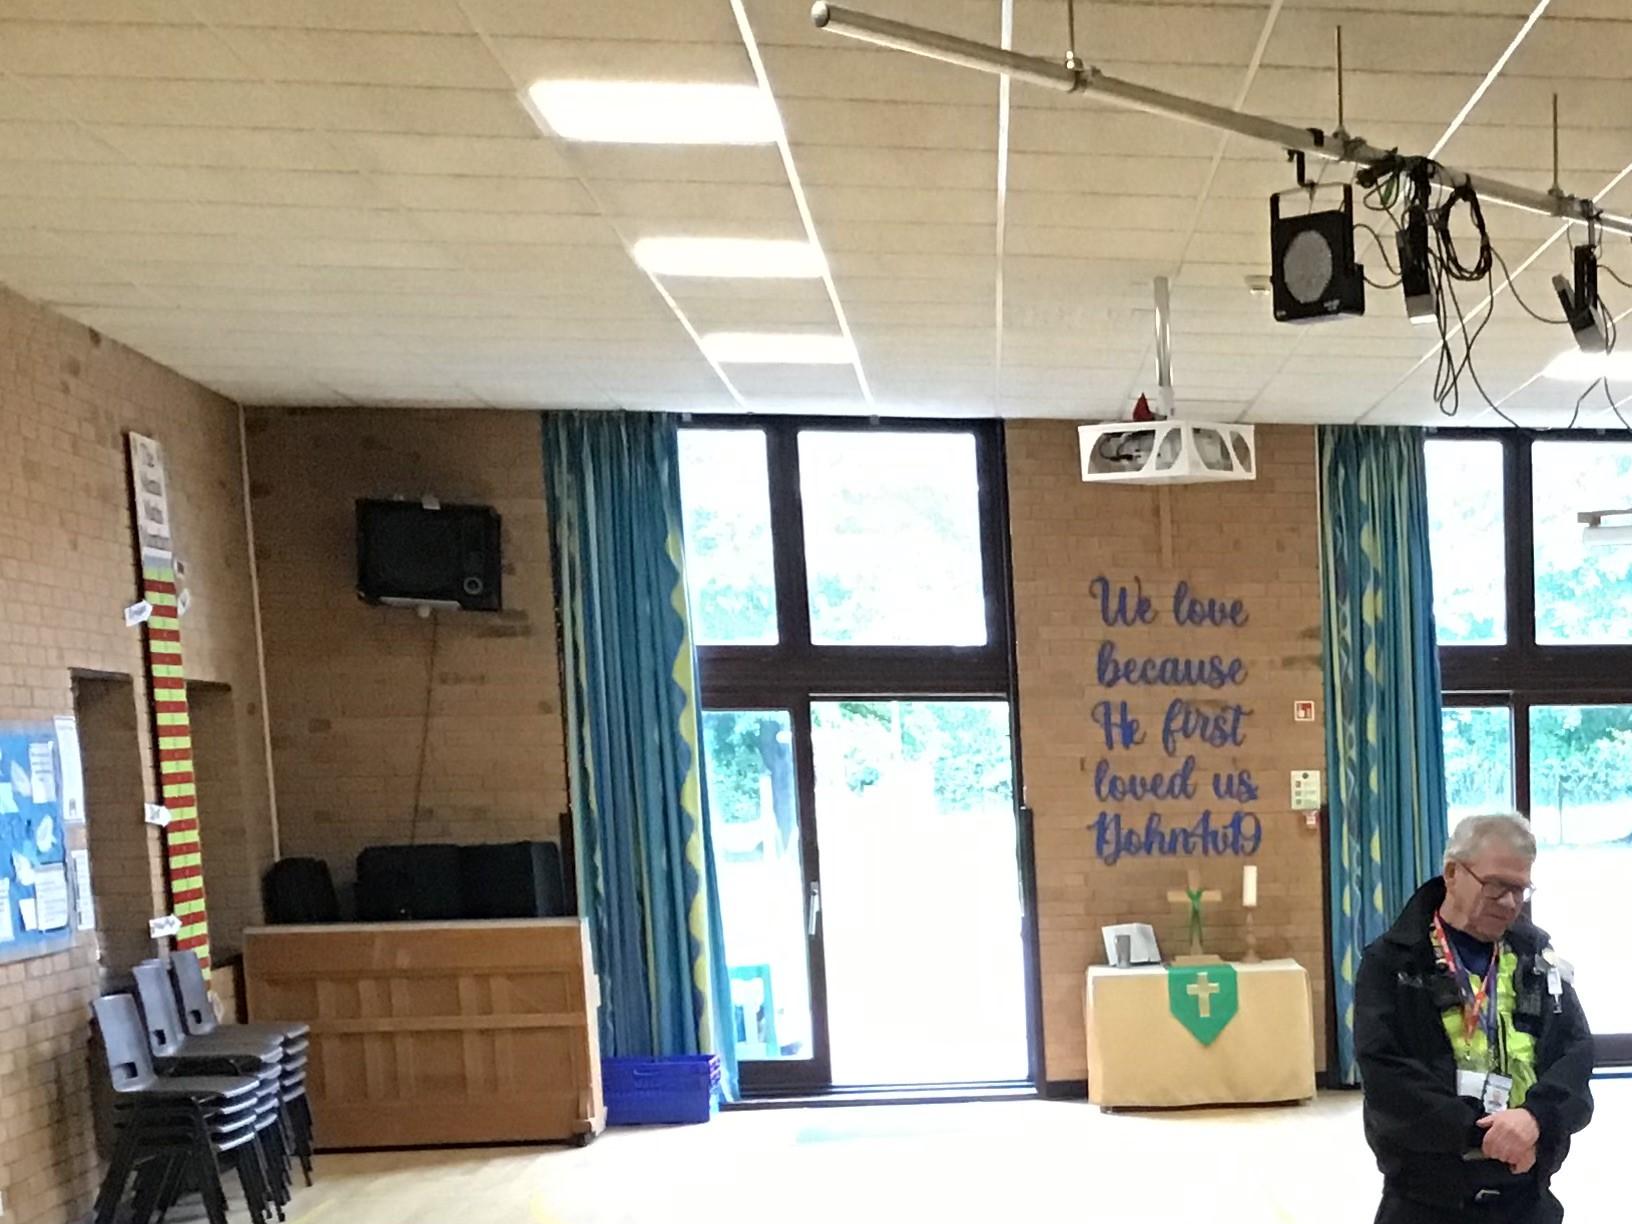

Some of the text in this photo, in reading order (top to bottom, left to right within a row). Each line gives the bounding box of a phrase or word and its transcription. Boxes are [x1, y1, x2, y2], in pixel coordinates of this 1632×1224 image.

[1088, 576, 1249, 627] We love
[1096, 640, 1249, 688] because
[1091, 698, 1254, 757] He first
[1094, 754, 1197, 802] loved
[1212, 769, 1260, 804] us
